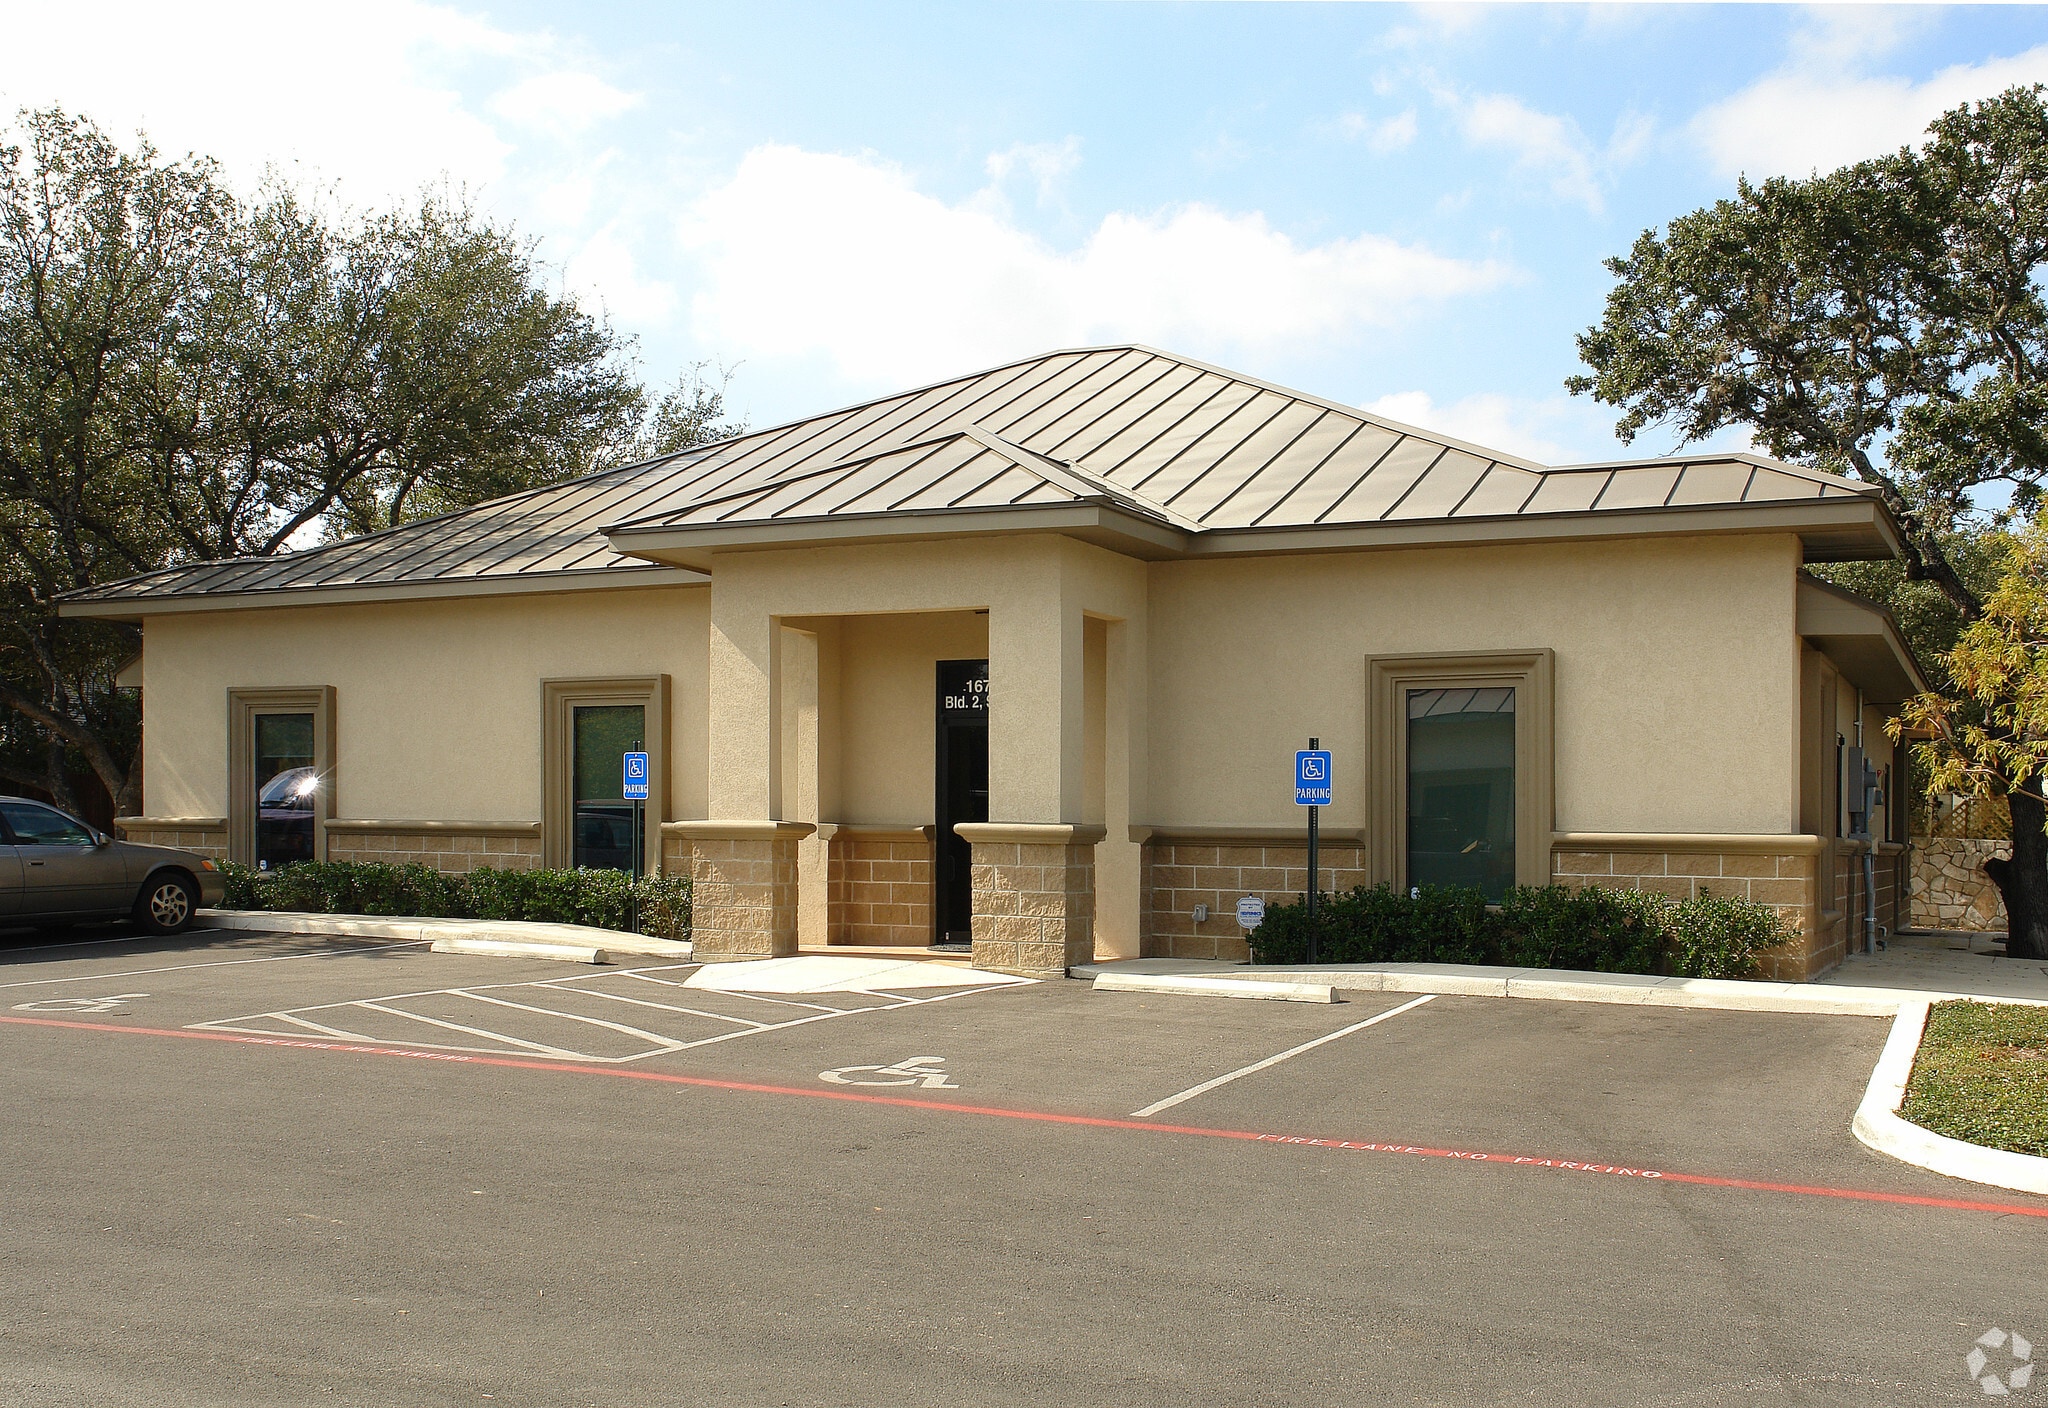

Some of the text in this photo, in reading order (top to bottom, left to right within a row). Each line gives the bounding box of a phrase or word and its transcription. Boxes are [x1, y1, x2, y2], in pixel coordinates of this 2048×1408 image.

[945, 695, 969, 709] Bld.
[972, 695, 983, 711] 2,
[624, 784, 648, 794] PARKING
[1296, 787, 1331, 799] PARKING
[1256, 1133, 1663, 1178] FIRE LANE NO PARKING
